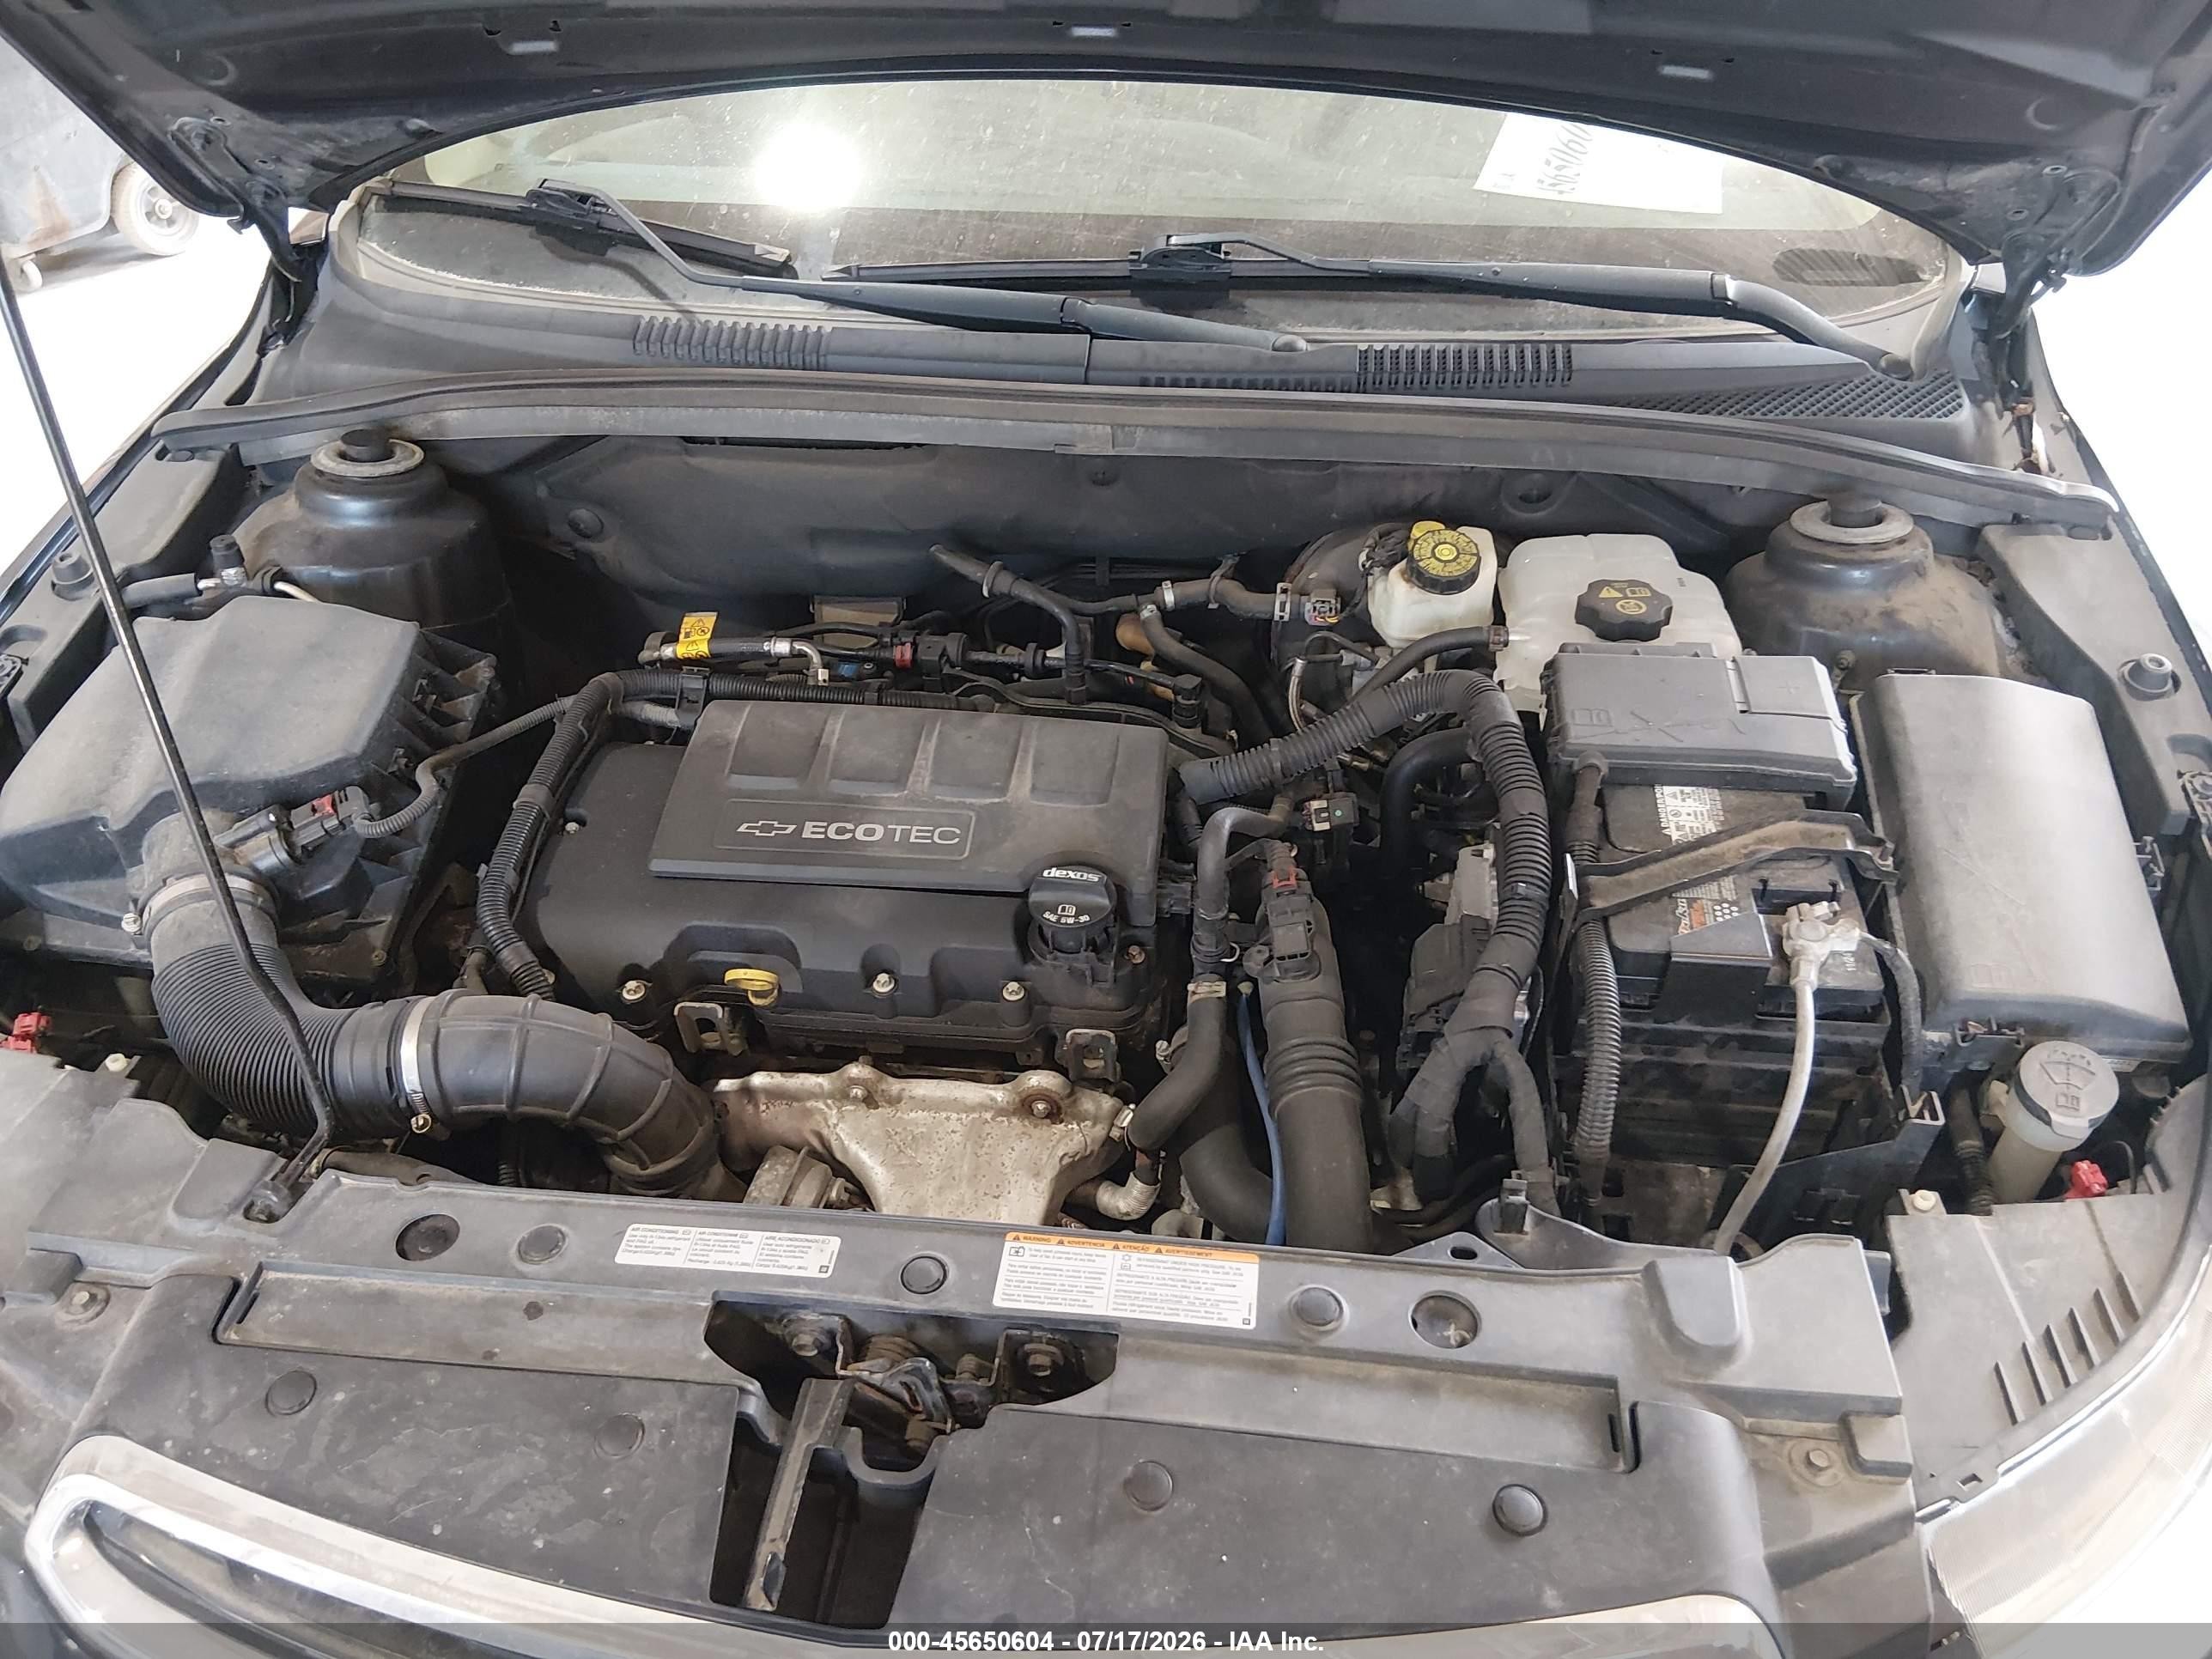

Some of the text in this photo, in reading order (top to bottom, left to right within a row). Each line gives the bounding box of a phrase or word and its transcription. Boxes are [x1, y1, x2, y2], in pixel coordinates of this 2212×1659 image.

[1654, 783, 1669, 829] DANGER/POI
[801, 821, 961, 844] ECOTEC
[1042, 867, 1102, 882] dexos
[1042, 911, 1091, 924] SAE 5W-30
